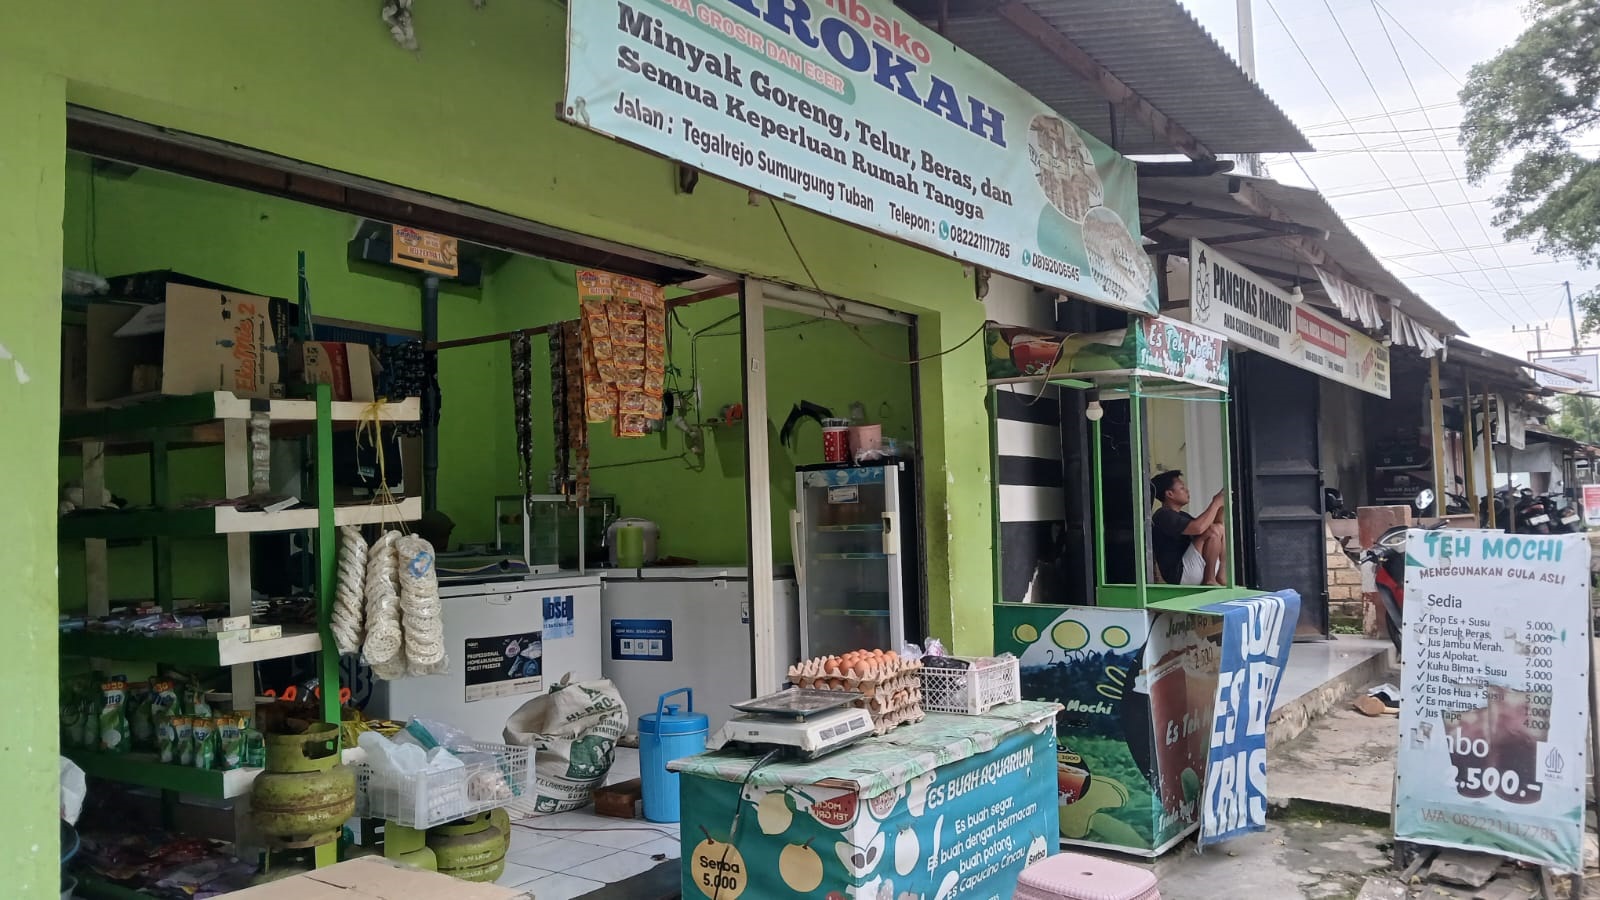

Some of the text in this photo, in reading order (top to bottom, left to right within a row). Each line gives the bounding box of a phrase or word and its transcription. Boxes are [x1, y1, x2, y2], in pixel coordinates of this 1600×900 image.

[697, 4, 764, 54] GROSIR
[767, 40, 802, 72] DAN
[803, 60, 845, 95] ECER
[728, 0, 1007, 148] ROKAH
[617, 1, 1013, 206] Minyak Goreng, Telur, Beras, dan
[617, 45, 984, 220] Semua Keperluan Rumah Tangga
[682, 117, 754, 167] Tegalrejo
[758, 150, 835, 201] Sumurgung
[838, 181, 874, 213] Tuban
[950, 224, 1010, 259] 082221117785
[1213, 262, 1257, 318] PANGKAS
[1259, 287, 1292, 334] RAMBUT
[1149, 324, 1163, 348] Es
[1423, 531, 1564, 562] TEH MOCHI
[1419, 565, 1566, 585] MENGGUNAKAN GULA ASLI
[1427, 593, 1463, 609] Sedia
[1429, 614, 1446, 626] Pop
[1448, 615, 1458, 625] Es
[1468, 617, 1491, 628] Susu
[1525, 620, 1553, 632] 5.000
[1428, 625, 1439, 635] Es
[1427, 637, 1441, 647] Jus
[1442, 639, 1471, 650] Jambu
[1525, 633, 1553, 644] 4.000
[1427, 650, 1441, 659] Jus
[1525, 646, 1553, 656] 5.000
[1427, 662, 1450, 672] Kuku
[1451, 663, 1474, 674] Bima
[1484, 666, 1508, 677] Susu
[1525, 658, 1553, 669] 7.000
[1426, 673, 1440, 683] Jus
[1525, 671, 1553, 681] 5.000
[1426, 685, 1436, 694] Es
[1438, 686, 1452, 696] Jos
[1453, 687, 1472, 698] Hua
[1525, 682, 1553, 693] 5.000
[1066, 699, 1114, 715] Mochi
[1426, 697, 1436, 706] Es
[1525, 693, 1553, 705] 5.000
[1425, 708, 1439, 718] Jus
[1523, 719, 1551, 730] 4.000
[928, 783, 945, 810] ES
[948, 770, 979, 802] BUAH
[981, 744, 1034, 785] AQUARIUM
[954, 796, 1015, 835] Es buah segar,
[940, 841, 965, 866] buah
[965, 821, 998, 848] dengan
[998, 803, 1038, 833] bermacam
[699, 855, 740, 874] Serba
[959, 850, 983, 875] buah
[959, 862, 1000, 892] Capucino
[1000, 846, 1026, 870] Cincau
[703, 872, 737, 891] 5.000
